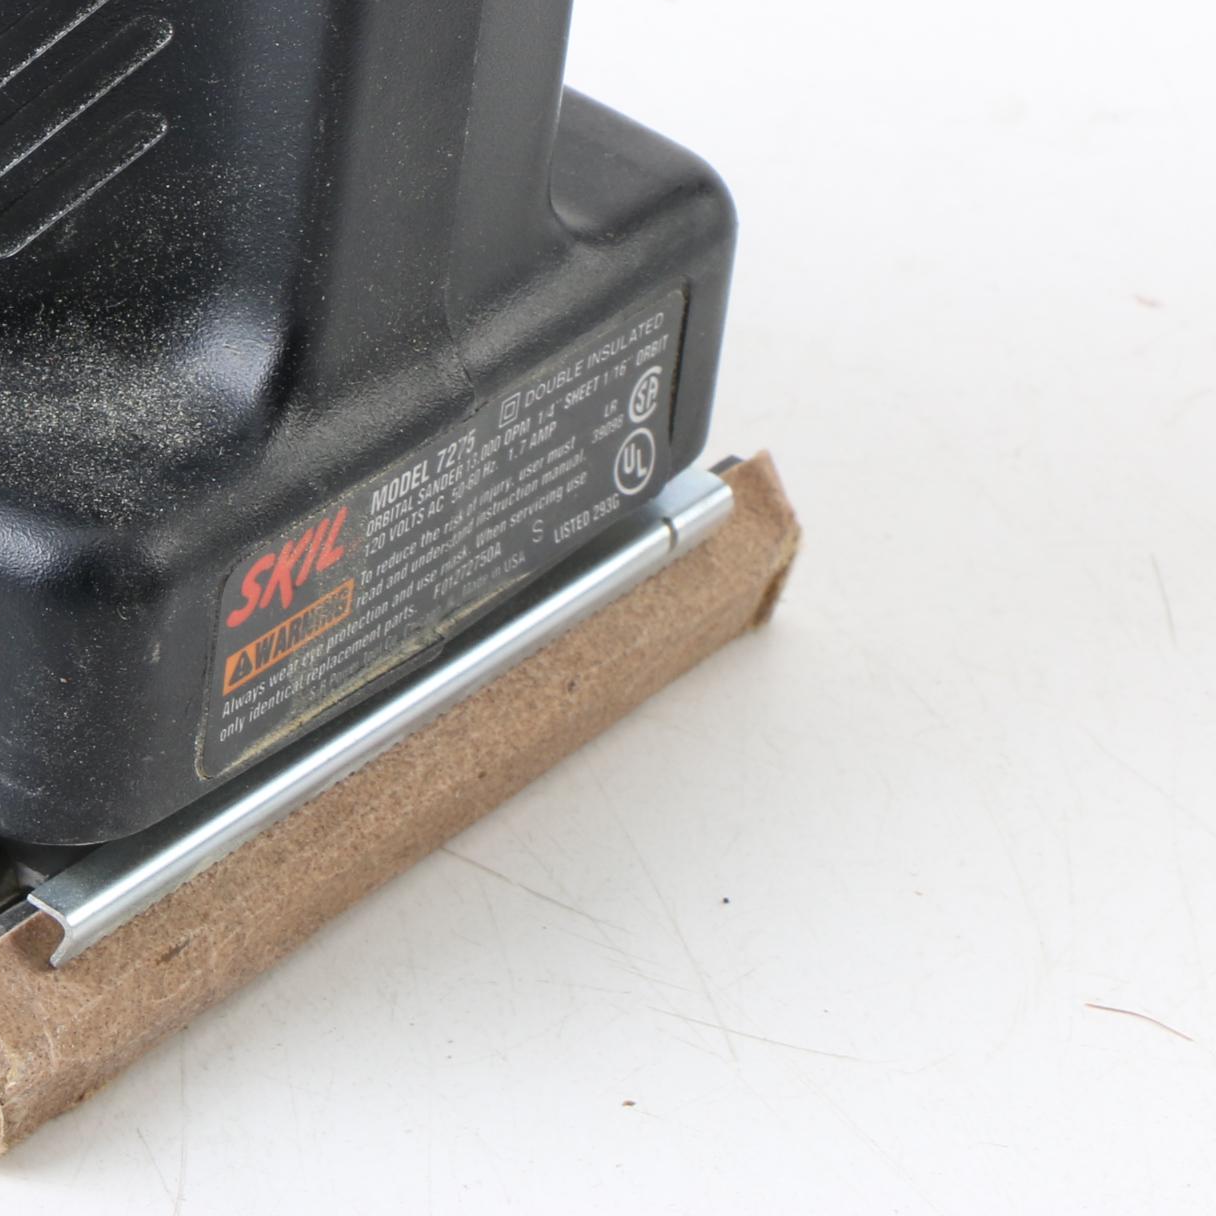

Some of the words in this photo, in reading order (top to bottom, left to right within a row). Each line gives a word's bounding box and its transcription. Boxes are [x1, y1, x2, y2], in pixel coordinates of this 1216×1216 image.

[525, 360, 584, 408] DOUBLE
[588, 312, 664, 368] INSULATED
[365, 532, 386, 557] 120
[390, 508, 424, 541] VOLTS
[428, 495, 444, 518] AC
[529, 421, 557, 449] AMP
[366, 496, 413, 537] ORBITAL
[417, 464, 463, 504] SANDER
[564, 376, 600, 409] SHEET
[636, 334, 669, 366] ORBIT
[370, 460, 429, 515] MODEL
[437, 429, 476, 473] 7275
[623, 443, 648, 478] UL
[227, 507, 347, 628] SKIL
[356, 578, 383, 608] read
[386, 563, 408, 589] and
[411, 518, 474, 573] understand
[476, 479, 538, 526] instruction
[361, 570, 372, 586] To
[376, 542, 416, 576] reduce
[421, 528, 440, 548] the
[444, 510, 462, 534] risk
[466, 496, 477, 516] of
[519, 458, 544, 480] user
[547, 436, 576, 464] must
[504, 550, 526, 573] USA
[554, 510, 590, 544] LISTED
[222, 682, 265, 718] Always
[270, 660, 298, 687] wear
[301, 644, 323, 667] eye
[326, 601, 388, 653] protection
[392, 580, 414, 608] and
[416, 570, 437, 590] use
[476, 520, 506, 548] When
[510, 486, 563, 527] servicing
[566, 472, 587, 492] use
[220, 717, 244, 742] only
[249, 674, 303, 722] identical
[306, 624, 381, 685] replacement
